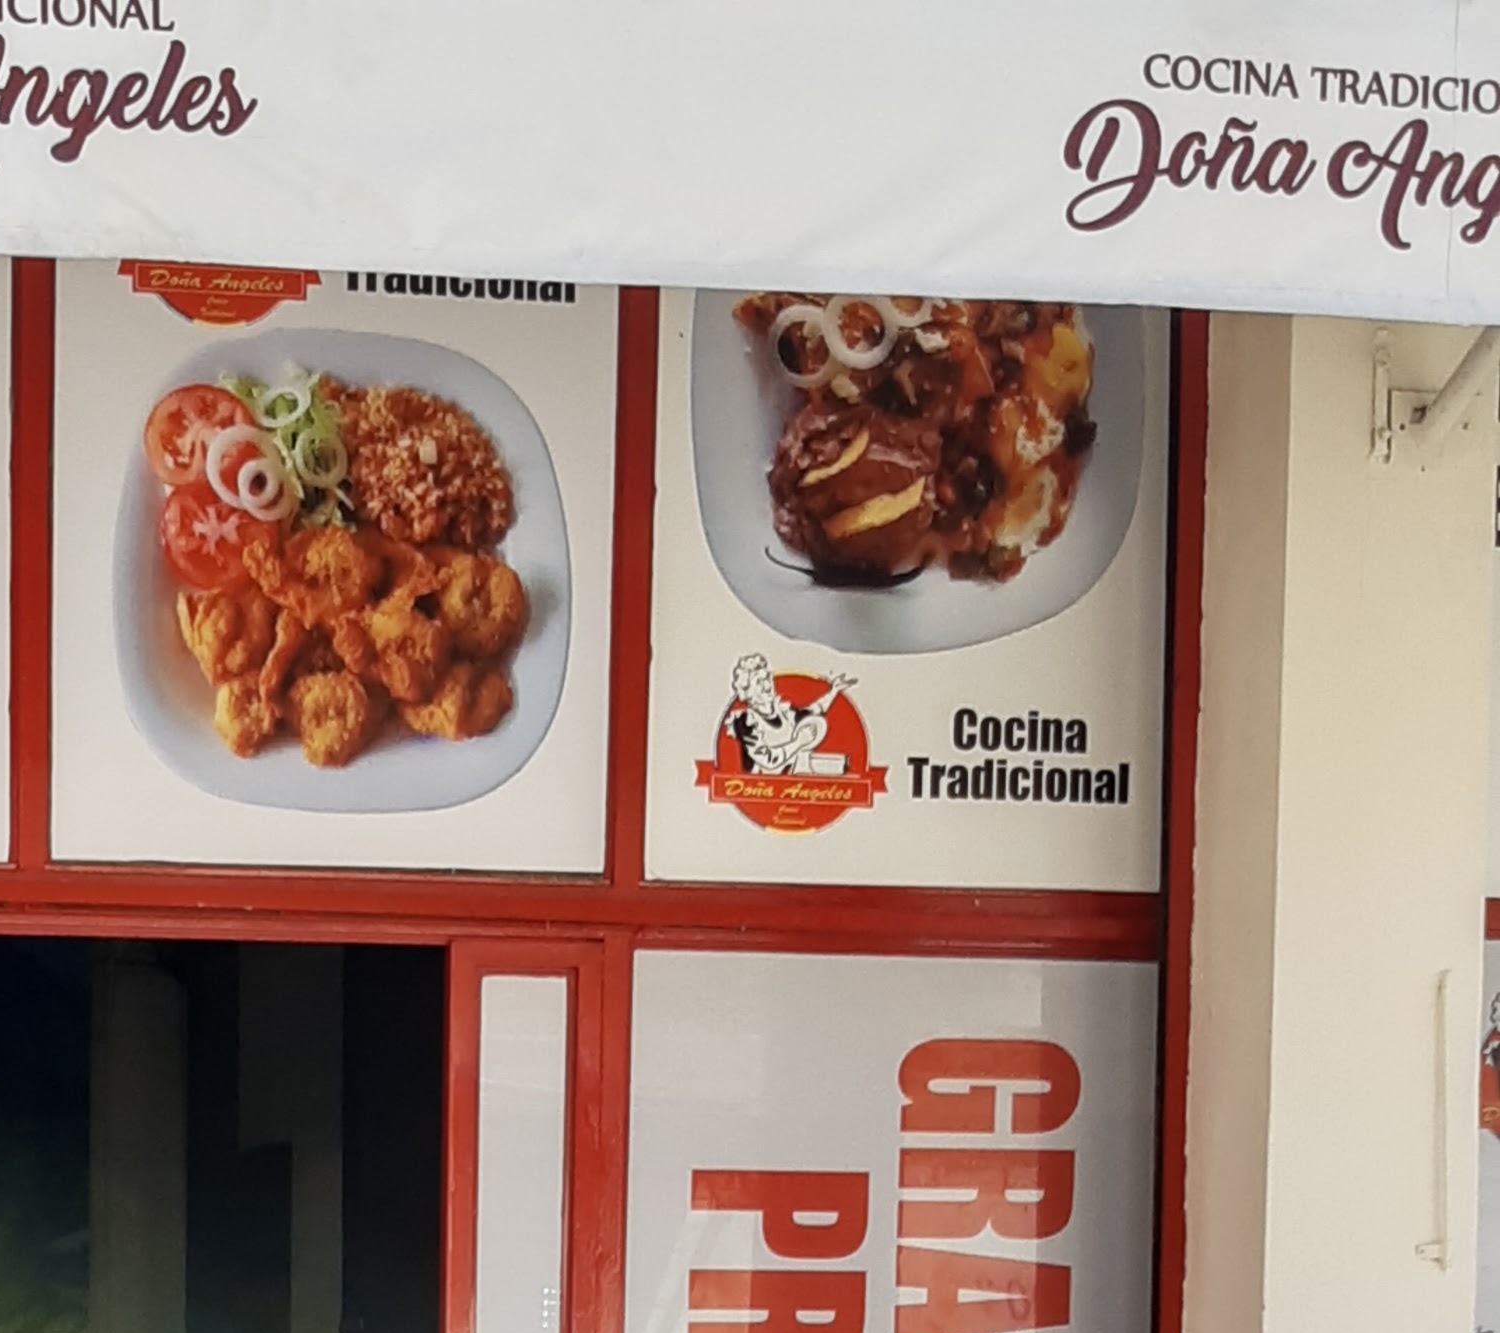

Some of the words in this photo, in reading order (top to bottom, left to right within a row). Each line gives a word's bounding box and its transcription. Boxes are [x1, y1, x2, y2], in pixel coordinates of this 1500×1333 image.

[1143, 53, 1300, 99] COCINA
[1310, 66, 1500, 114] TRADICIO
[1063, 98, 1317, 232] Doña
[1326, 118, 1500, 250] Ang
[150, 269, 201, 287] Doña
[208, 273, 284, 294] Angeles
[953, 708, 1088, 754] Cocina
[724, 779, 774, 797] Doña
[780, 782, 853, 803] Angeles
[907, 757, 1130, 805] Tradicional
